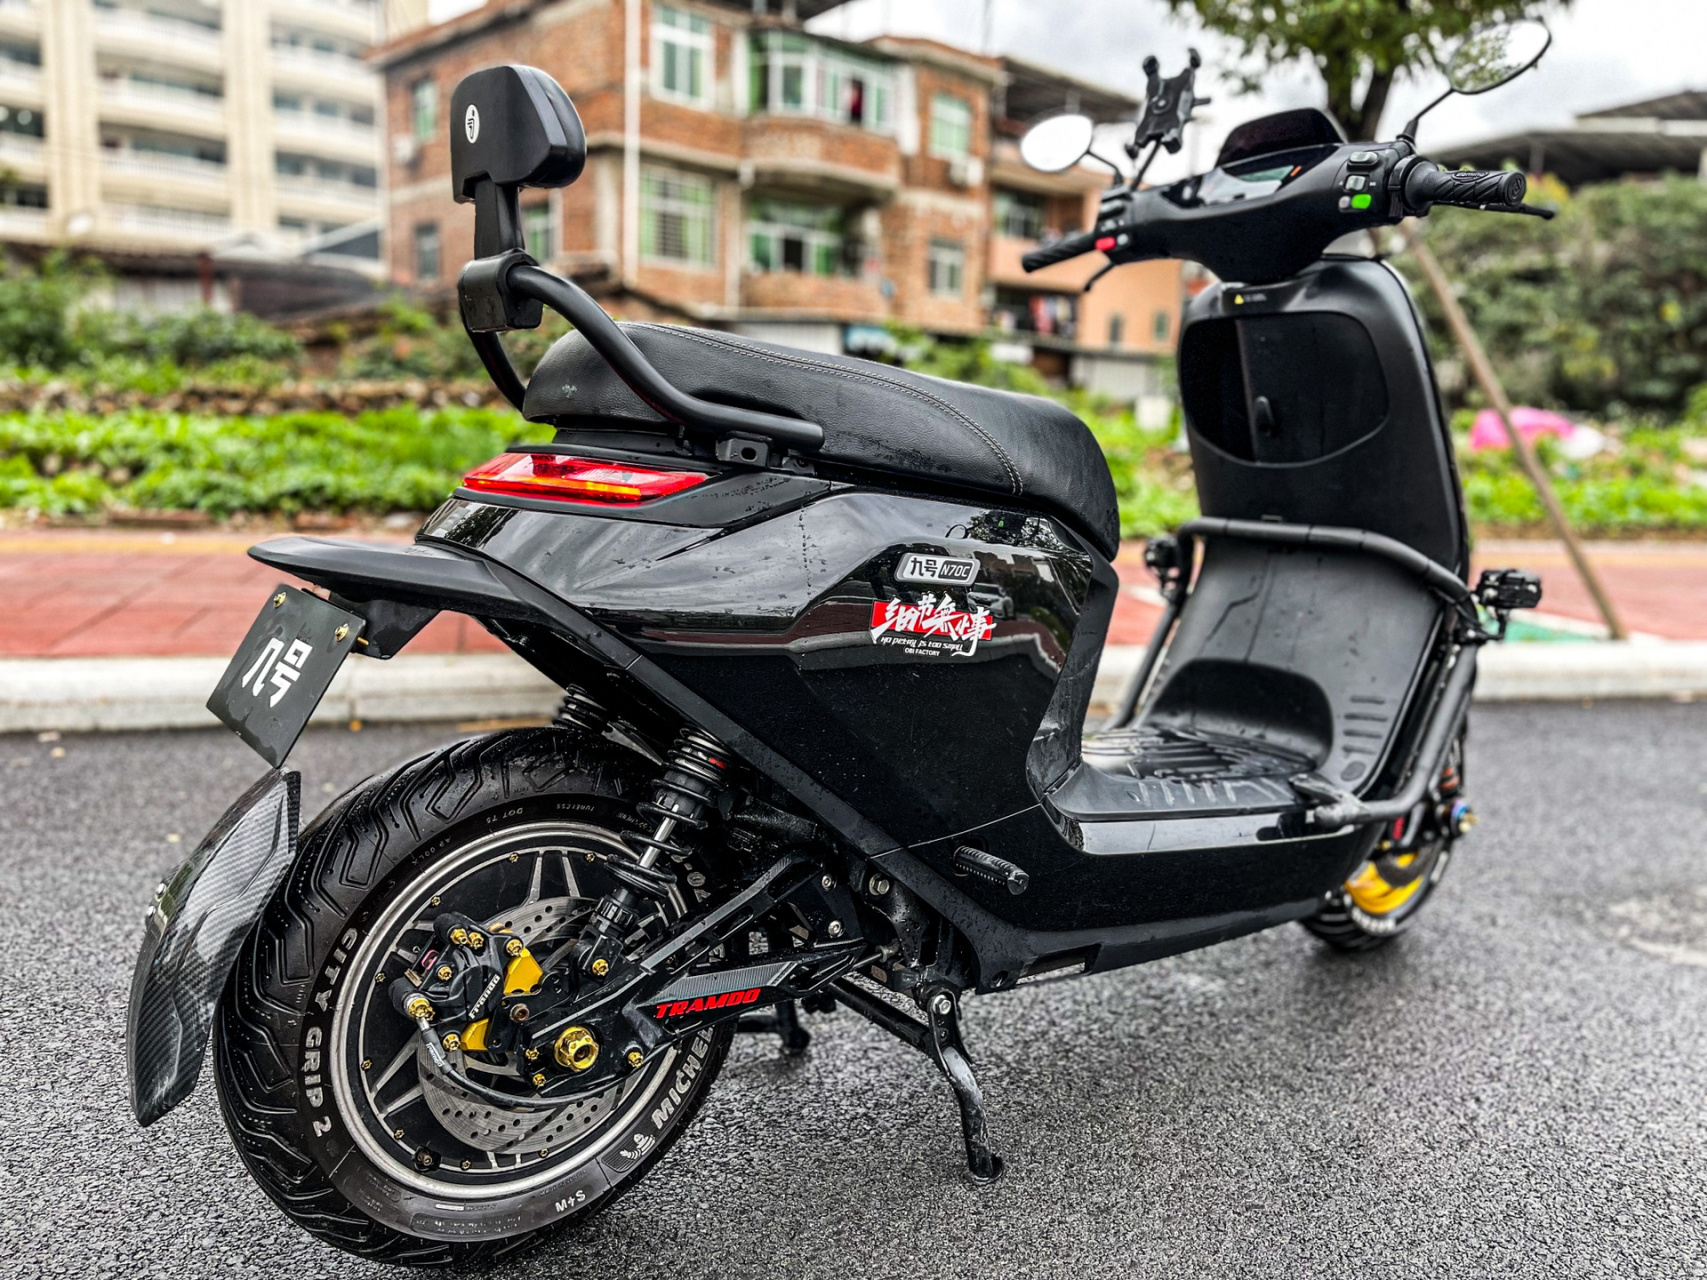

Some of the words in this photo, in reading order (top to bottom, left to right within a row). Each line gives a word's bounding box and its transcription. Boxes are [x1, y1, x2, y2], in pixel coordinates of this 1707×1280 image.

[909, 557, 938, 577] 九号
[941, 563, 971, 577] N70C
[915, 648, 941, 657] FACTORY
[502, 807, 524, 820] DOT
[314, 927, 358, 1012] CITY
[655, 988, 762, 1019] TRAMDO
[301, 1026, 323, 1108] GRIP
[651, 1023, 717, 1130] MICHEL
[311, 1115, 332, 1138] 2
[555, 1189, 587, 1213] M+S
